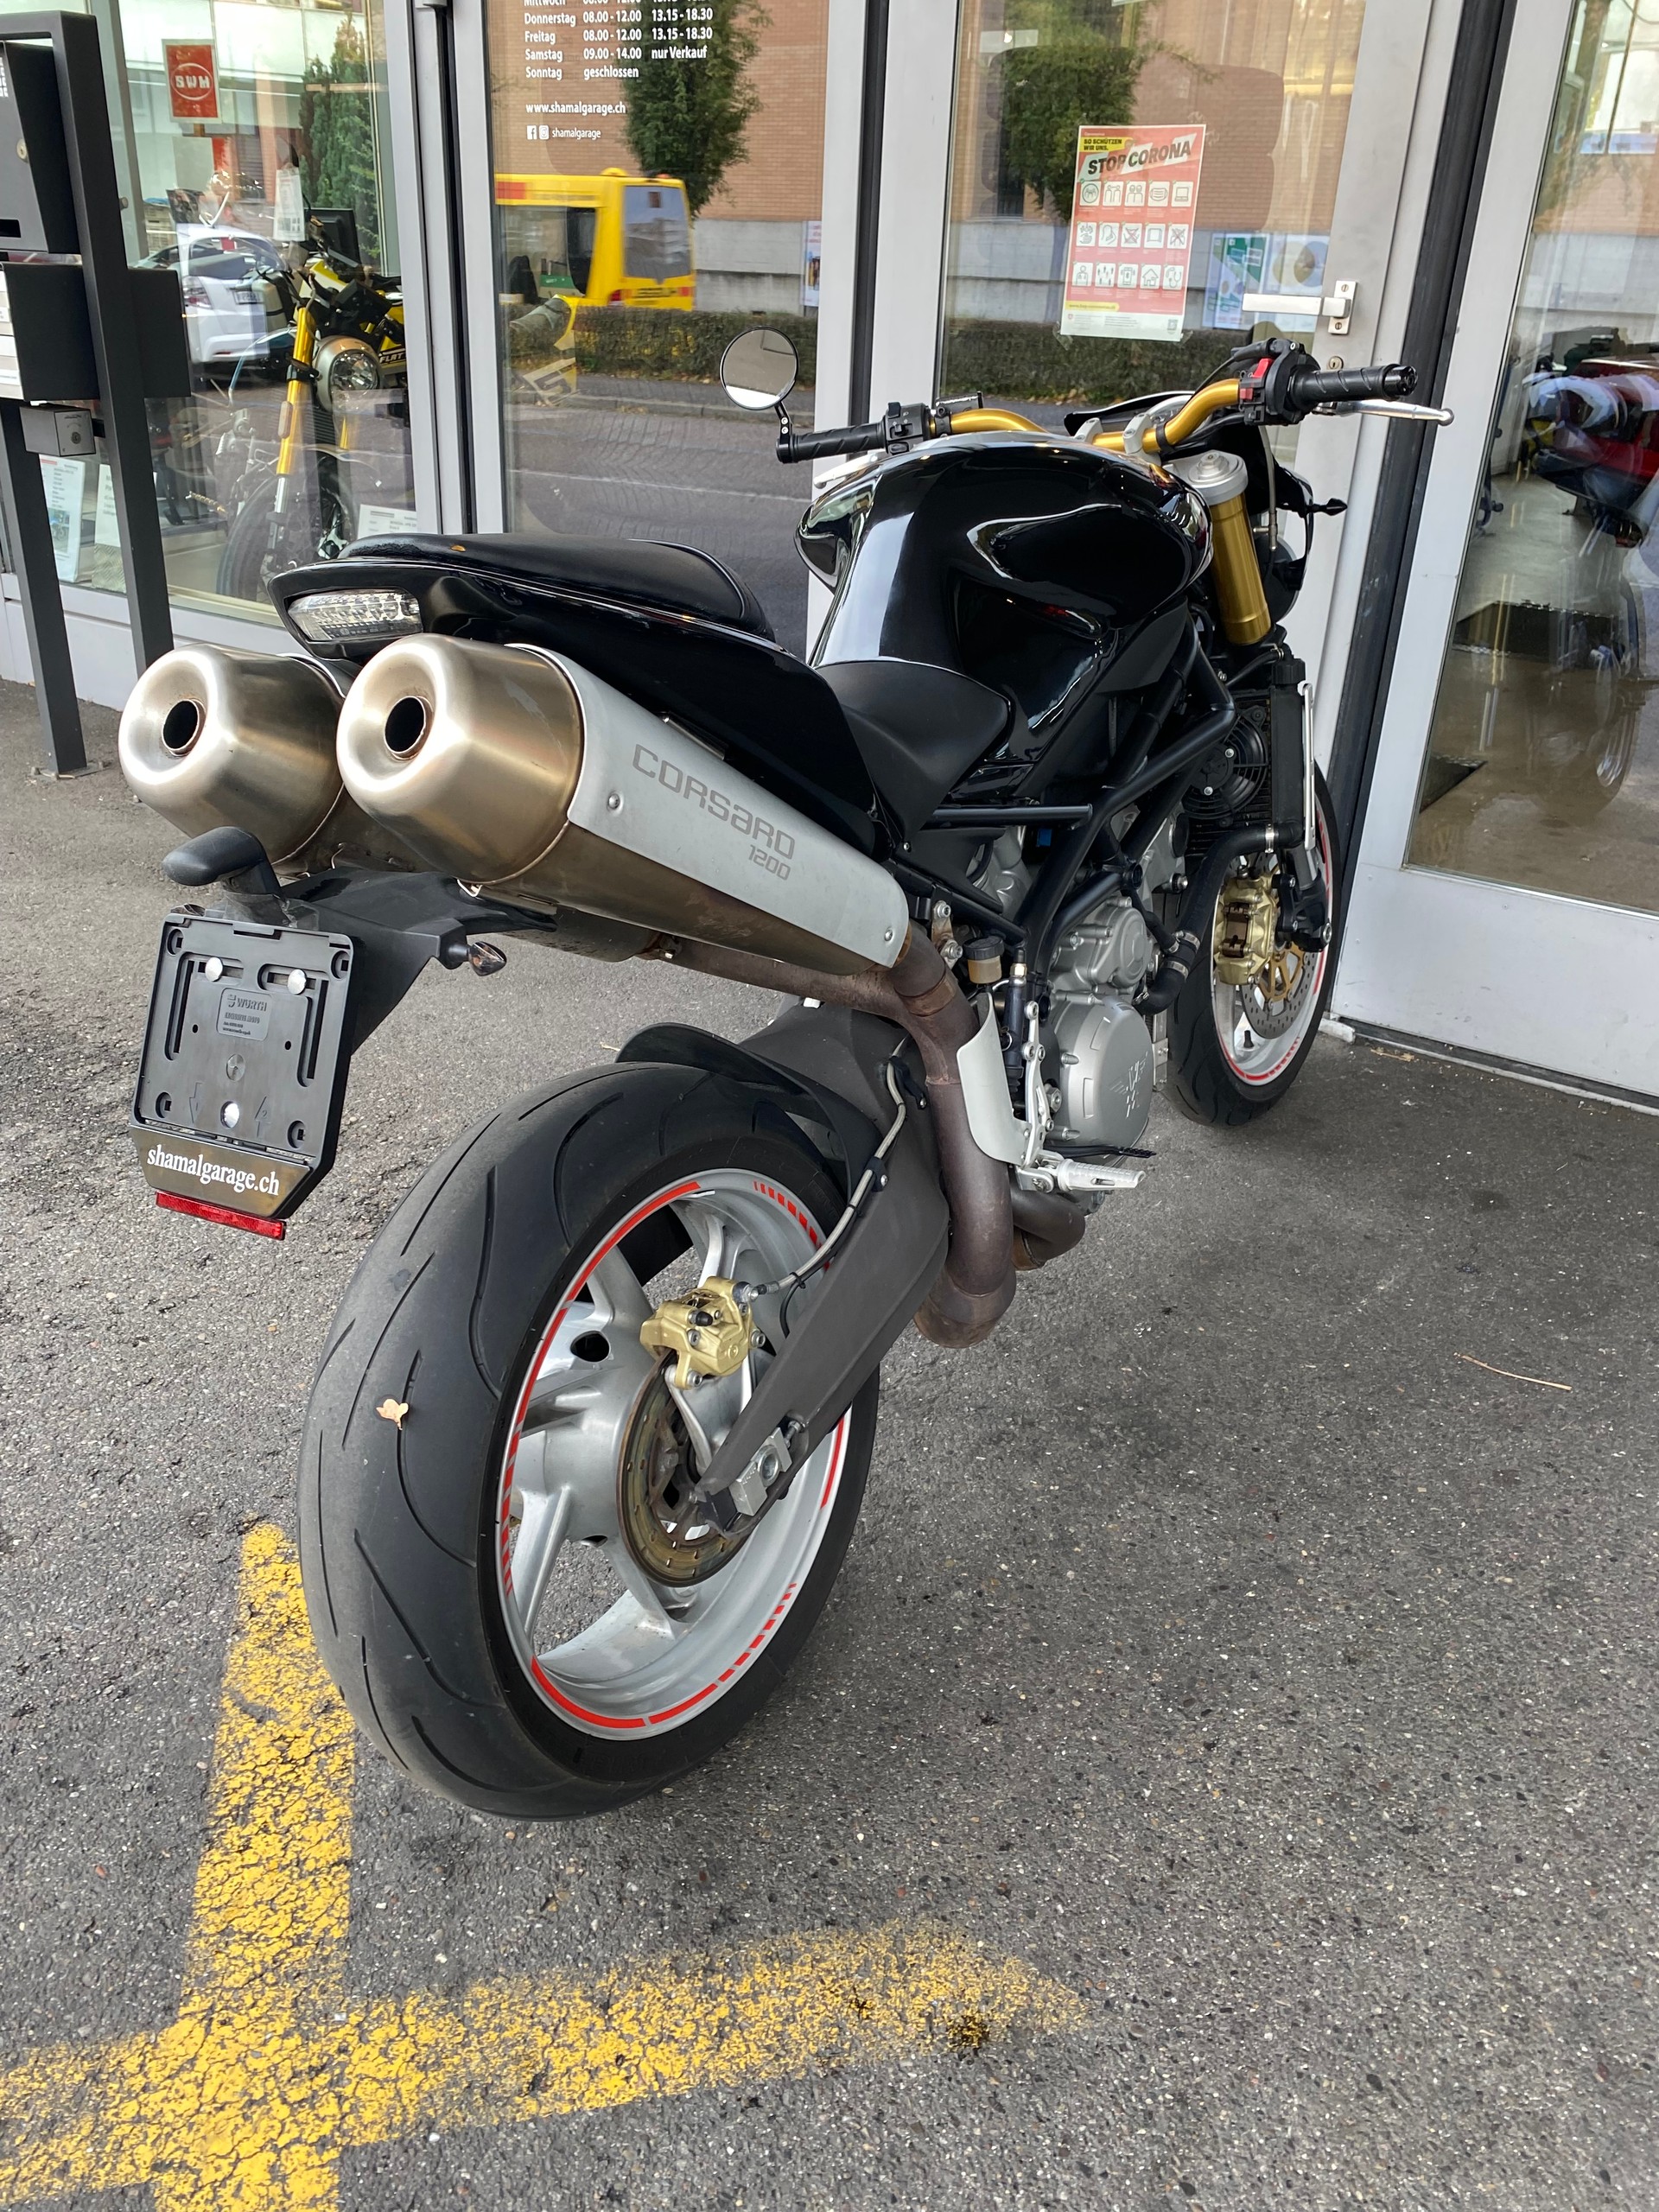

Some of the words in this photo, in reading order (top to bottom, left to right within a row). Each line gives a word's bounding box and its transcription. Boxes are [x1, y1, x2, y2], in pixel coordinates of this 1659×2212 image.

[524, 13, 576, 27] Donnerstag
[583, 11, 608, 23] 08.00
[616, 10, 642, 22] 12.00
[652, 9, 678, 22] 13.15
[686, 7, 713, 21] 18.30
[524, 30, 556, 45] Freitag
[583, 29, 608, 41] 08.00
[616, 29, 642, 41] 12.00
[652, 28, 678, 41] 13.15
[686, 27, 713, 40] 18.30
[525, 48, 563, 62] Samstag
[583, 48, 609, 60] 09.00
[616, 47, 642, 60] 14.00
[651, 48, 669, 59] nur
[669, 45, 708, 59] Verkauf
[525, 66, 563, 80] Sonntag
[583, 65, 639, 80] geschlossen
[175, 74, 210, 89] SWM
[525, 101, 626, 116] www.shamalgarage.ch
[551, 127, 601, 139] shamalgarage
[1088, 155, 1127, 175] STOP
[1128, 141, 1192, 168] CORONA
[748, 844, 791, 880] 1200
[147, 1144, 280, 1196] shamalgarage.ch
